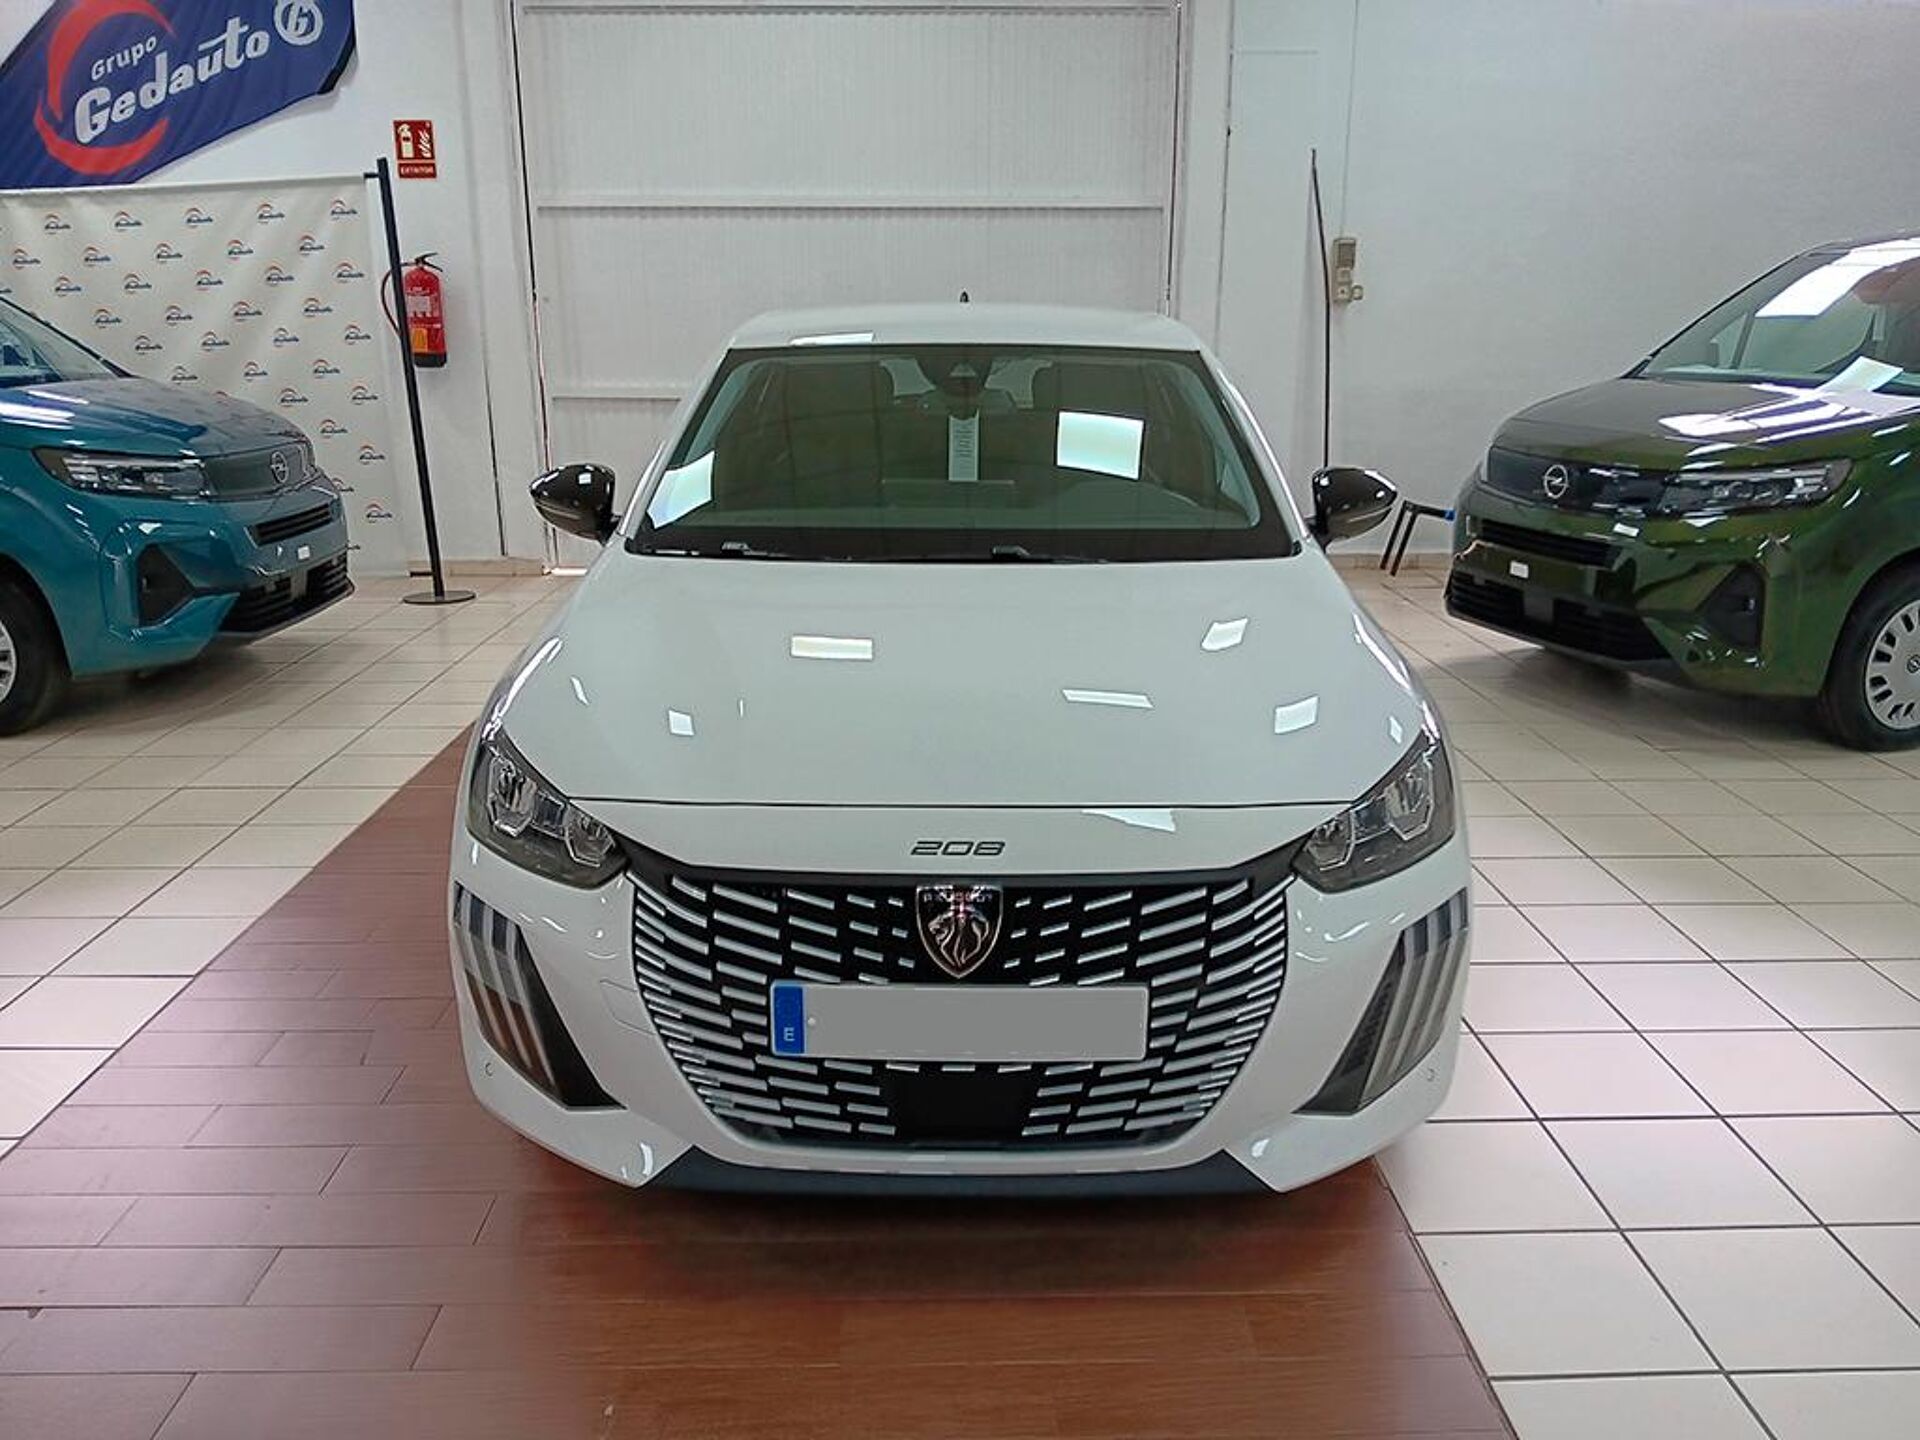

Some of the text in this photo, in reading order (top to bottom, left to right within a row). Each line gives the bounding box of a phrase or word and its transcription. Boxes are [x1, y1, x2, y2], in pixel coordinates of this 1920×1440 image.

[91, 36, 157, 81] Grupo
[73, 16, 270, 144] Gedauto
[910, 841, 1006, 855] 208
[783, 1026, 796, 1042] E
